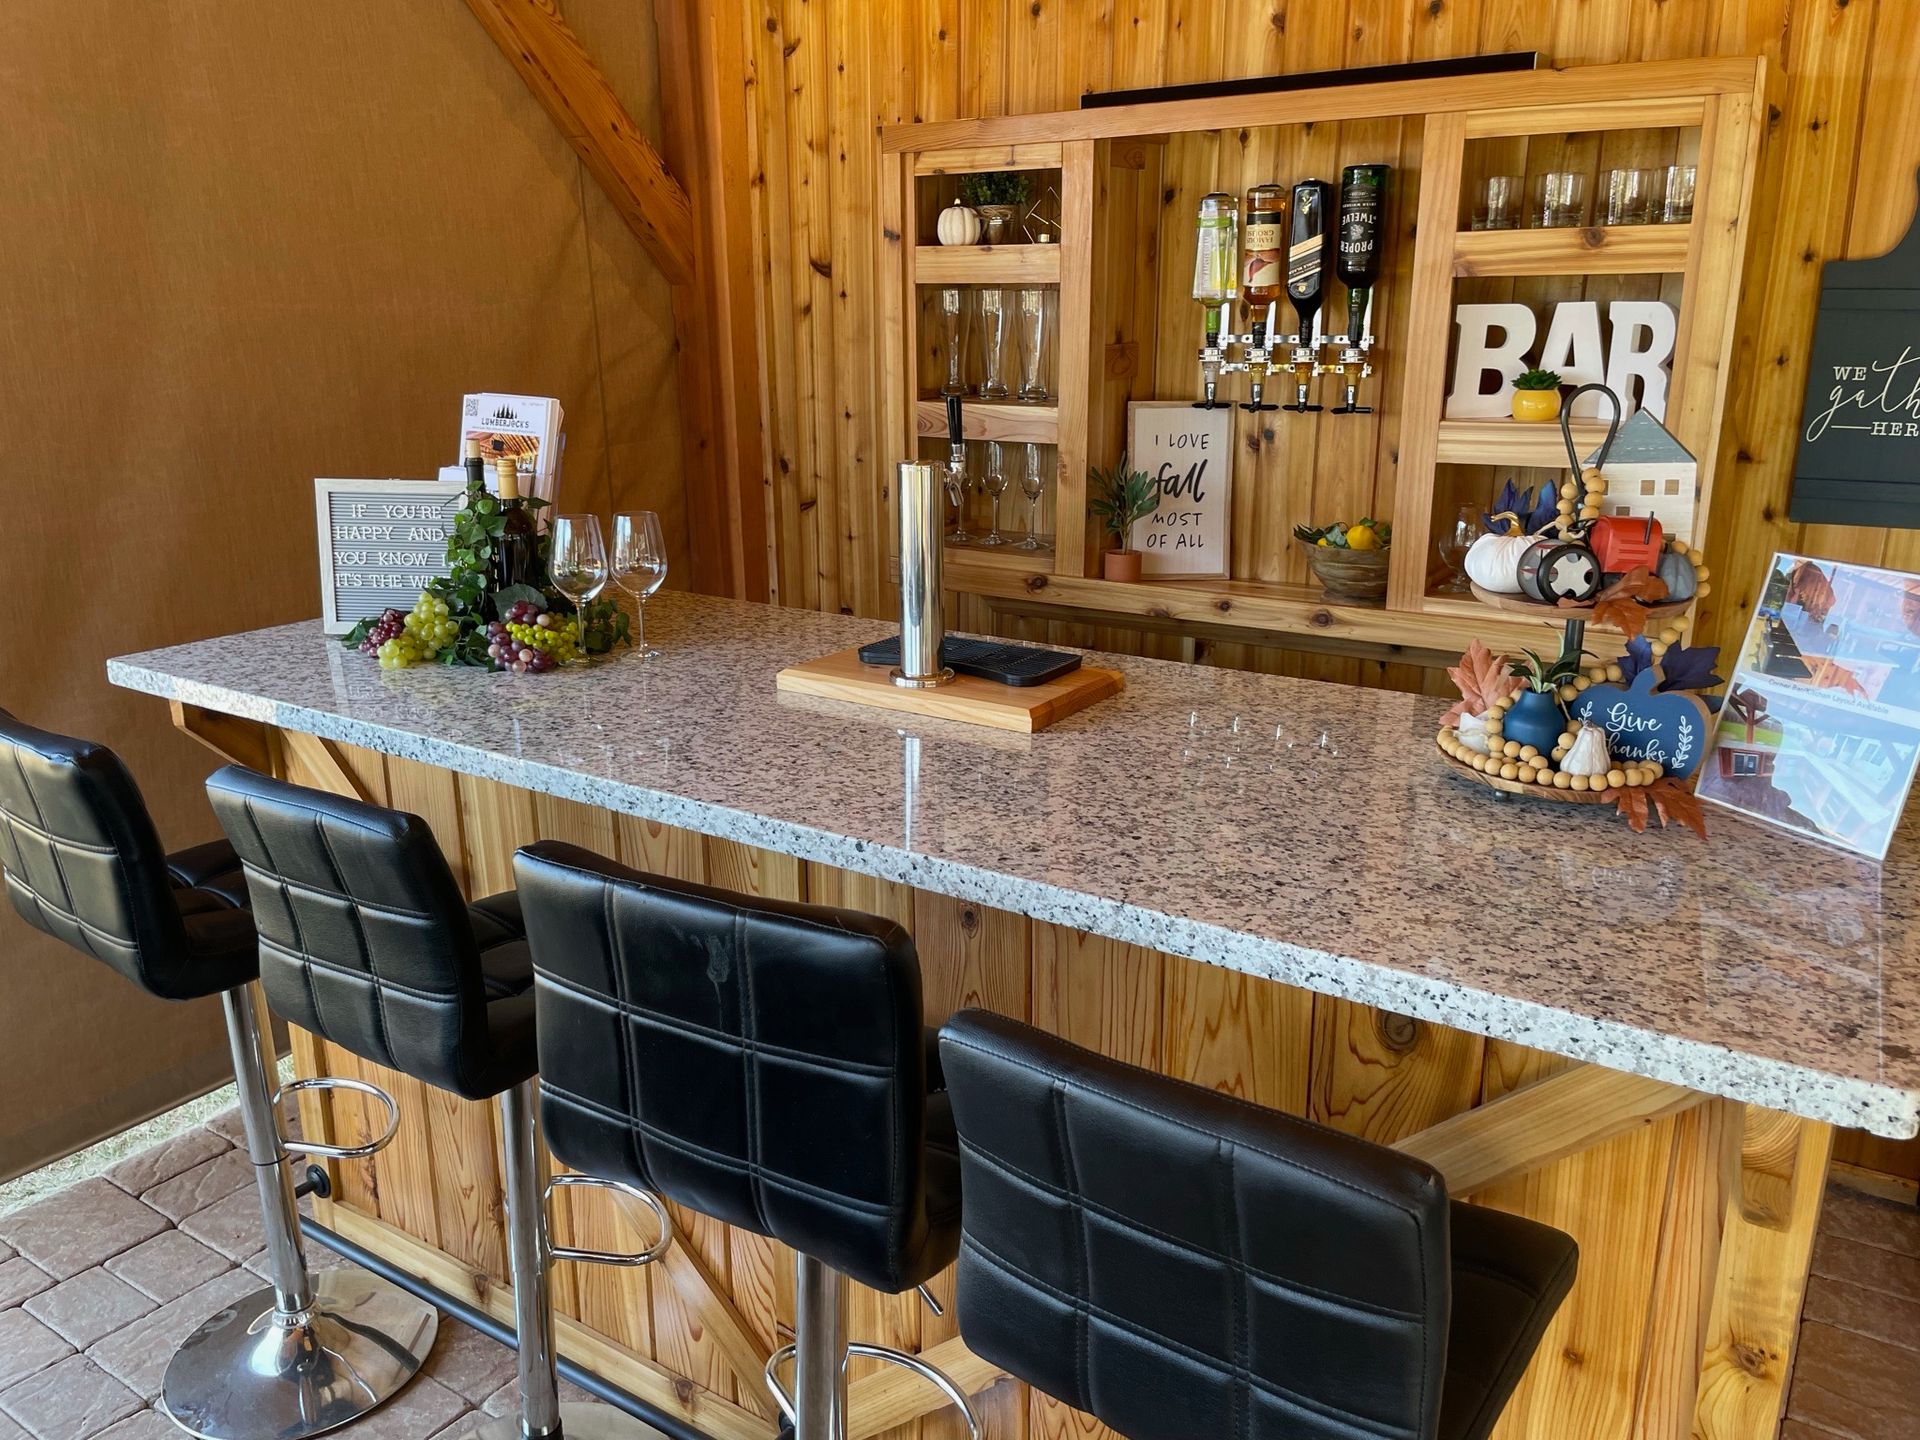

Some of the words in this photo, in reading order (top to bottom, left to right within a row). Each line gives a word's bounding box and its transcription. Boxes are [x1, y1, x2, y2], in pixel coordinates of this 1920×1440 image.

[1341, 212, 1374, 225] TWELVE
[1340, 239, 1373, 253] PROPER
[1445, 301, 1679, 422] BAR
[1833, 366, 1867, 381] WE
[1870, 421, 1920, 437] HER
[1154, 434, 1159, 446] I
[1169, 433, 1211, 450] LOVE
[1155, 459, 1208, 507] fall
[351, 504, 368, 519] IF
[383, 505, 442, 519] YOU'RE
[1151, 512, 1204, 526] MOST
[335, 526, 393, 540] HAPPY
[408, 528, 444, 541] AND
[1147, 533, 1167, 548] OF
[1176, 534, 1204, 549] ALL
[334, 552, 367, 565] YOU
[378, 552, 429, 567] KNOW
[335, 573, 363, 587] IT'S
[369, 575, 402, 589] THE
[1605, 702, 1662, 733] Give
[1605, 732, 1668, 764] hanks
